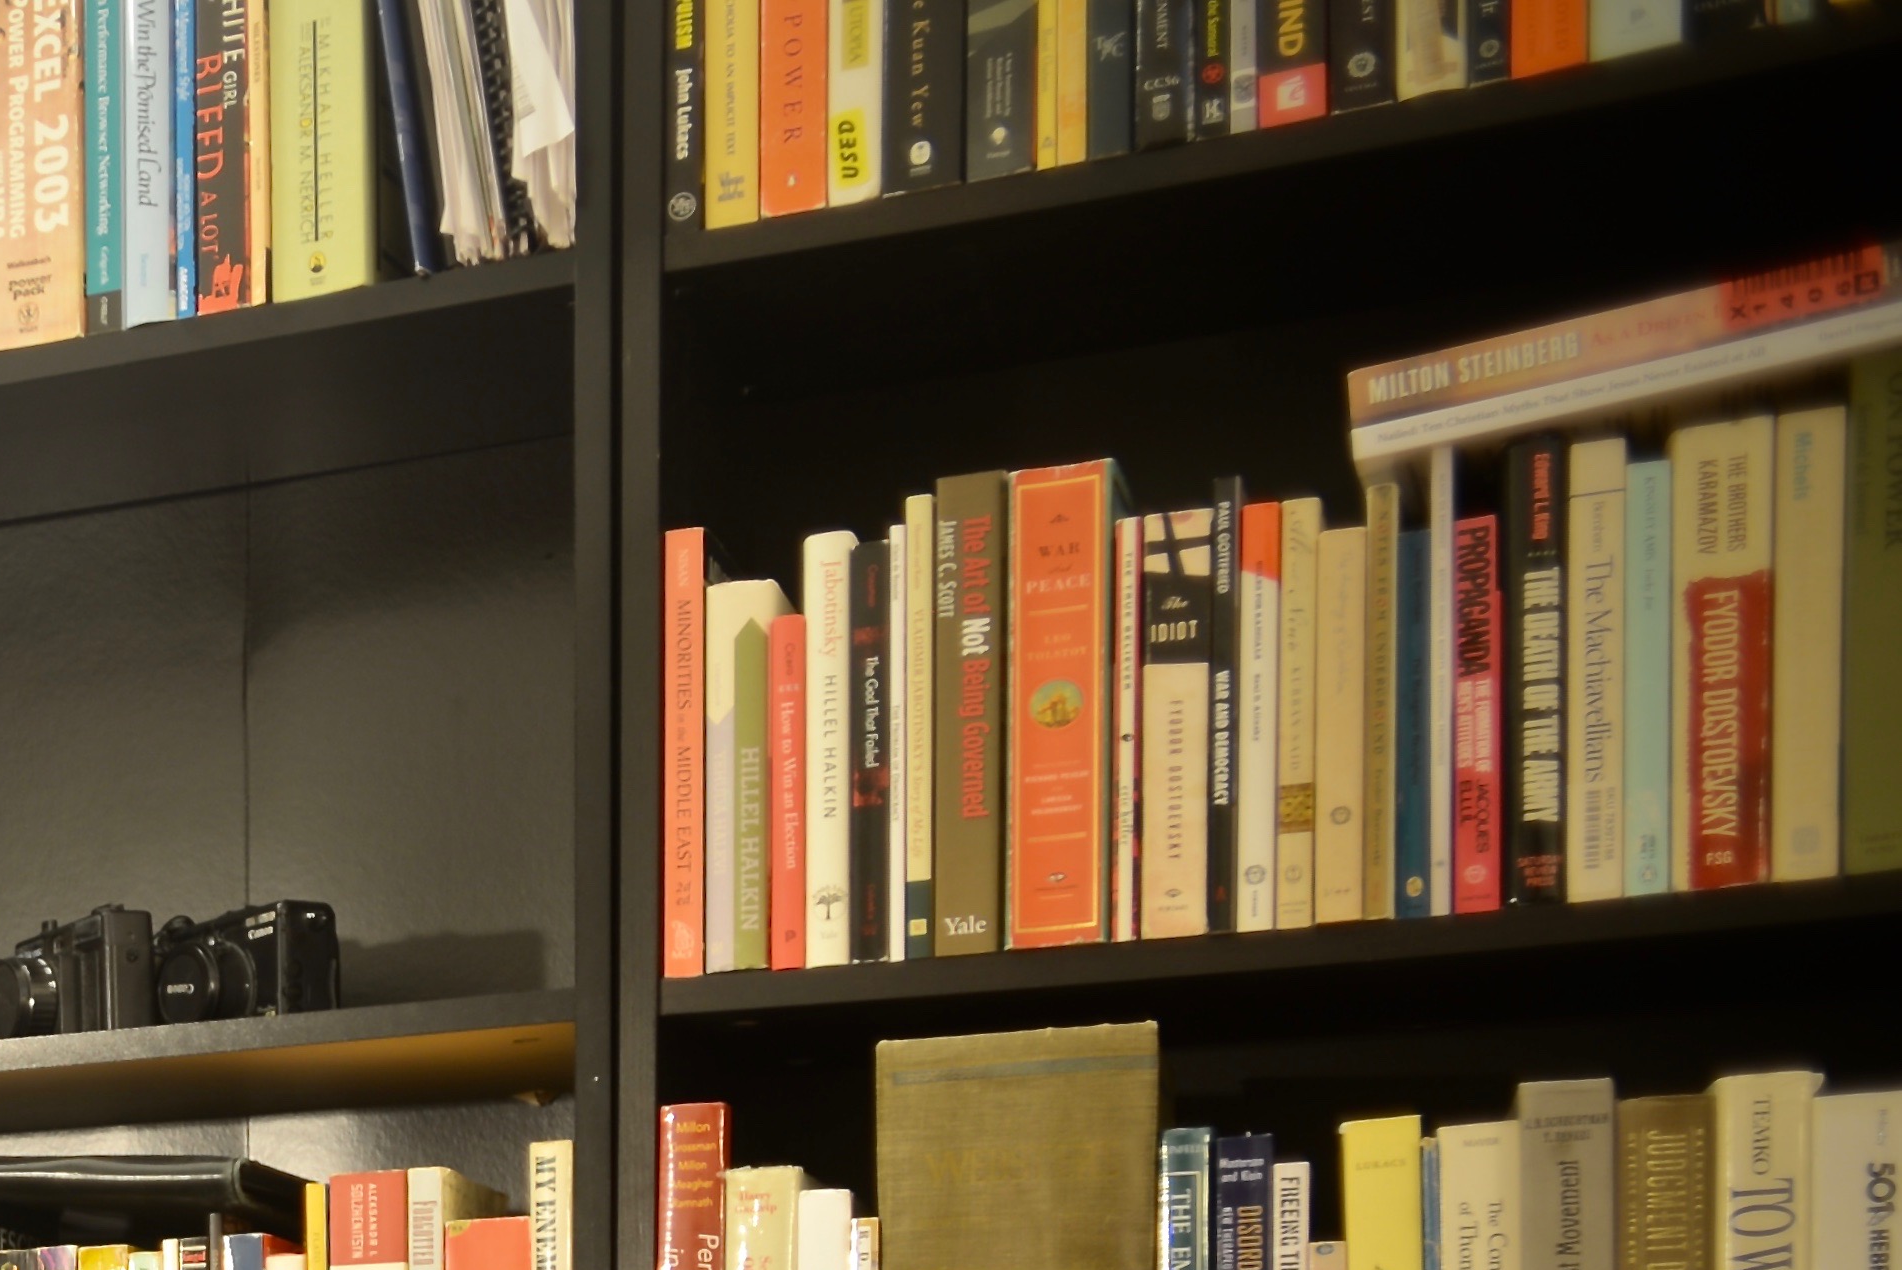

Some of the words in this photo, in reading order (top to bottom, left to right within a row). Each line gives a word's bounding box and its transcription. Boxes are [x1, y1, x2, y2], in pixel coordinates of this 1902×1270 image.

[839, 120, 858, 179] USED
[1368, 369, 1450, 406] MILTON
[1456, 333, 1580, 383] STEINBERG
[963, 515, 990, 551] The
[963, 558, 990, 590] Art
[1456, 526, 1488, 677] PROPAGANDA
[963, 597, 987, 613] of
[961, 618, 990, 655] Not
[1702, 590, 1738, 687] FYODOR
[960, 660, 990, 713] Being
[960, 723, 990, 820] Governed
[1702, 690, 1738, 836] DOSTOEVSKY
[945, 916, 986, 936] Yale
[1170, 1189, 1191, 1232] THE
[1730, 1179, 1793, 1236] TO
